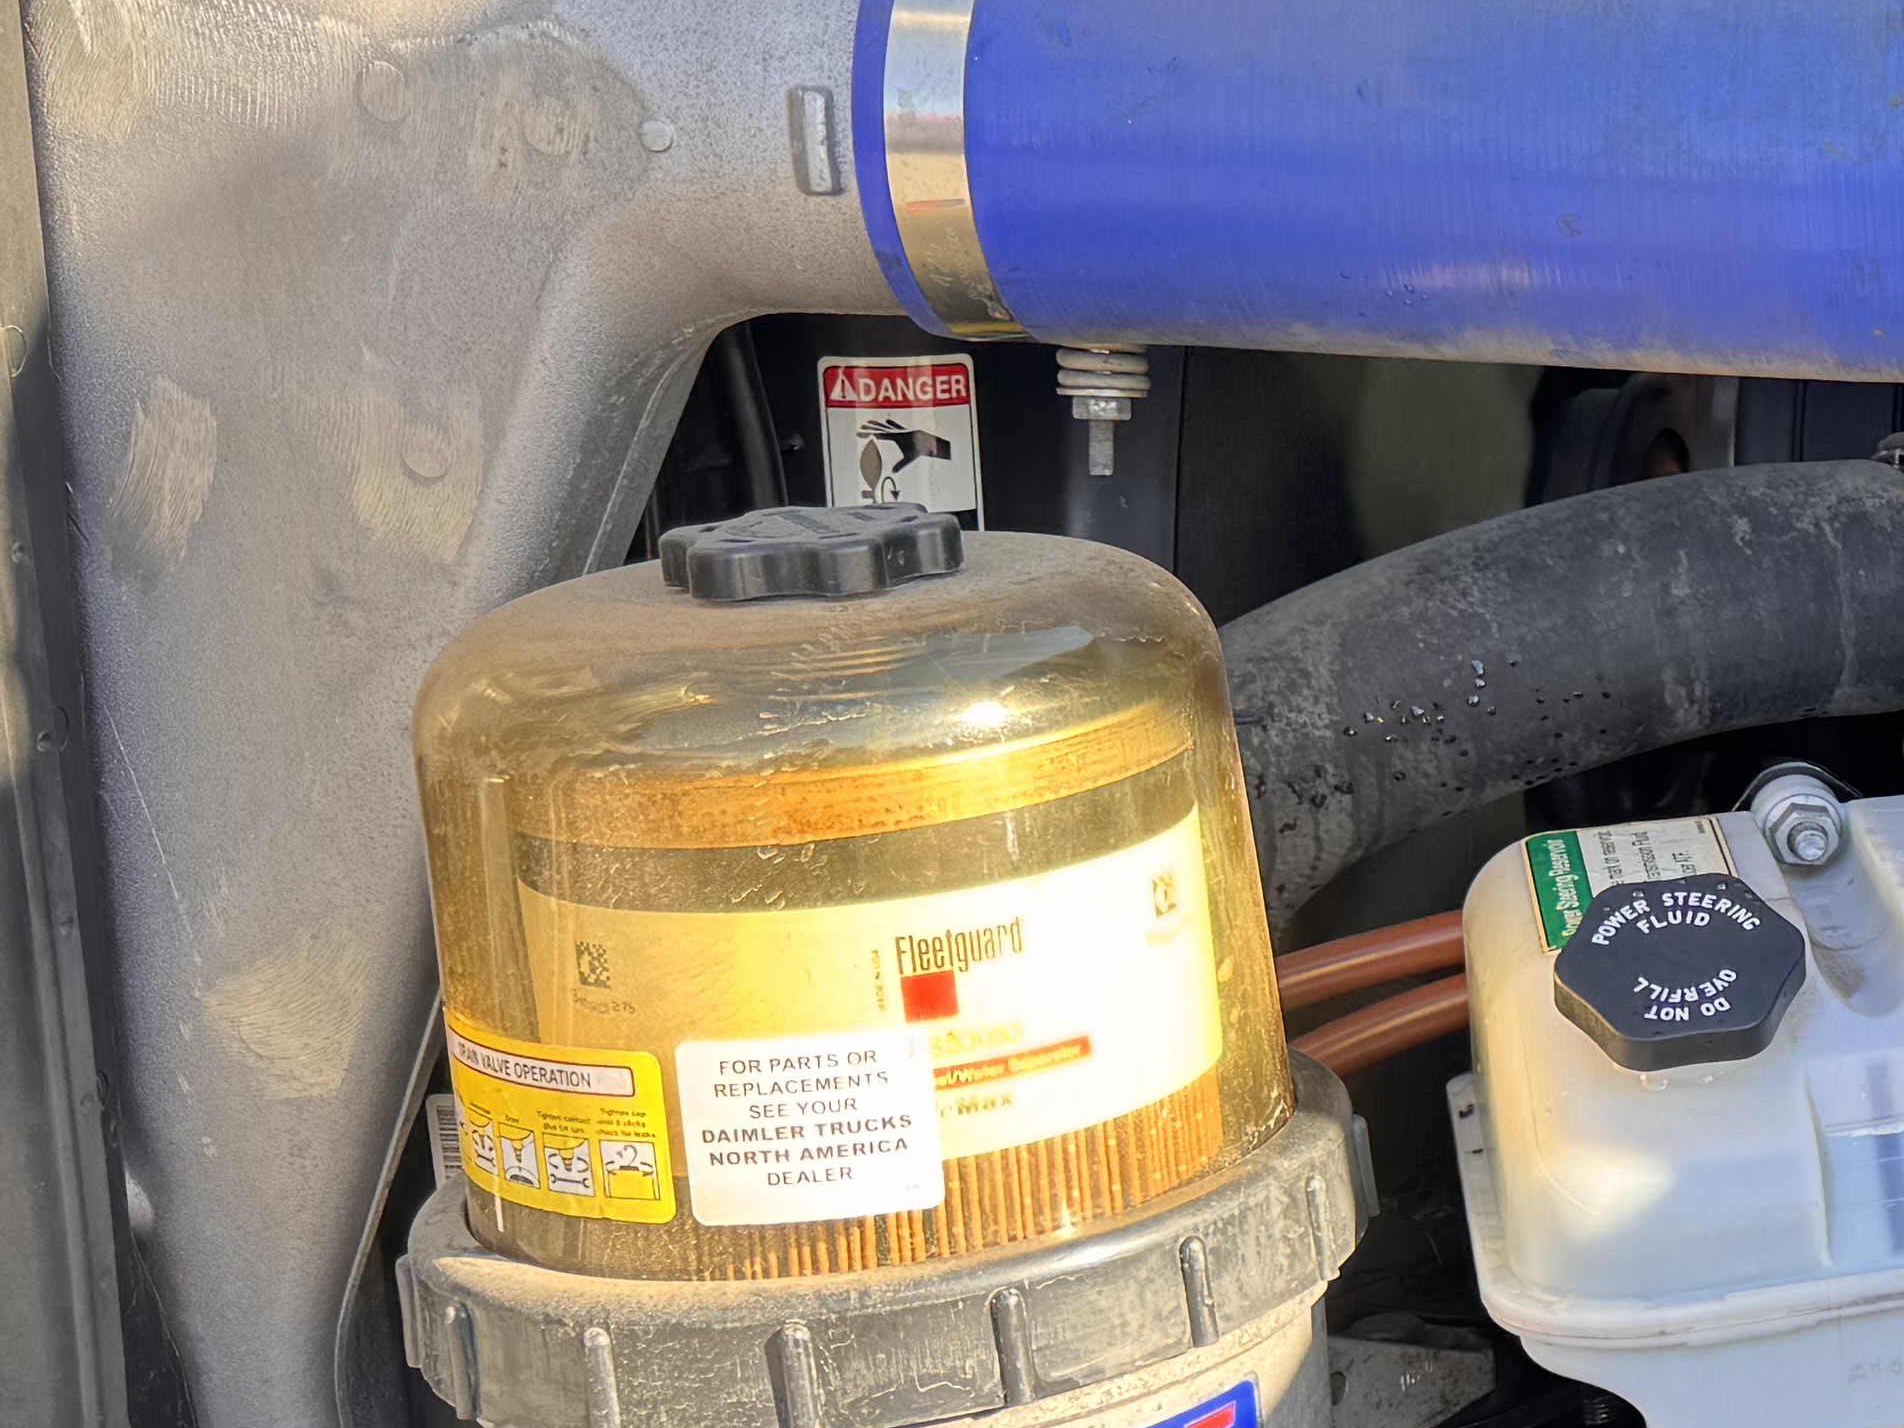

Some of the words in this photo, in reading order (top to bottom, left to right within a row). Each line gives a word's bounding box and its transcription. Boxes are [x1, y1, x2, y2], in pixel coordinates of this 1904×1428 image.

[858, 374, 967, 402] DANGER
[1542, 838, 1571, 876] Reservoir
[1552, 874, 1581, 910] Steering
[1591, 898, 1651, 945] POWER
[1661, 891, 1761, 931] STEERING
[1636, 910, 1711, 934] FLUID
[894, 915, 1023, 974] Fleetguard
[1633, 968, 1738, 1002] OVERFILL
[1643, 1006, 1691, 1022] NOT
[1699, 996, 1732, 1017] DO
[480, 1053, 512, 1077] VALVE
[514, 1061, 592, 1089] OPERATION
[718, 1058, 762, 1076] FOR
[769, 1053, 839, 1074] PARTS
[846, 1049, 877, 1066] OR
[713, 1071, 889, 1098] REPLACEMENTS
[748, 1102, 790, 1119] SEE
[796, 1097, 858, 1117] YOUR
[701, 1124, 806, 1144] DAIMLER
[813, 1114, 912, 1137] TRUCKS
[709, 1148, 790, 1167] NORTH
[799, 1137, 909, 1162] AMERICA
[766, 1166, 853, 1186] DEALER
